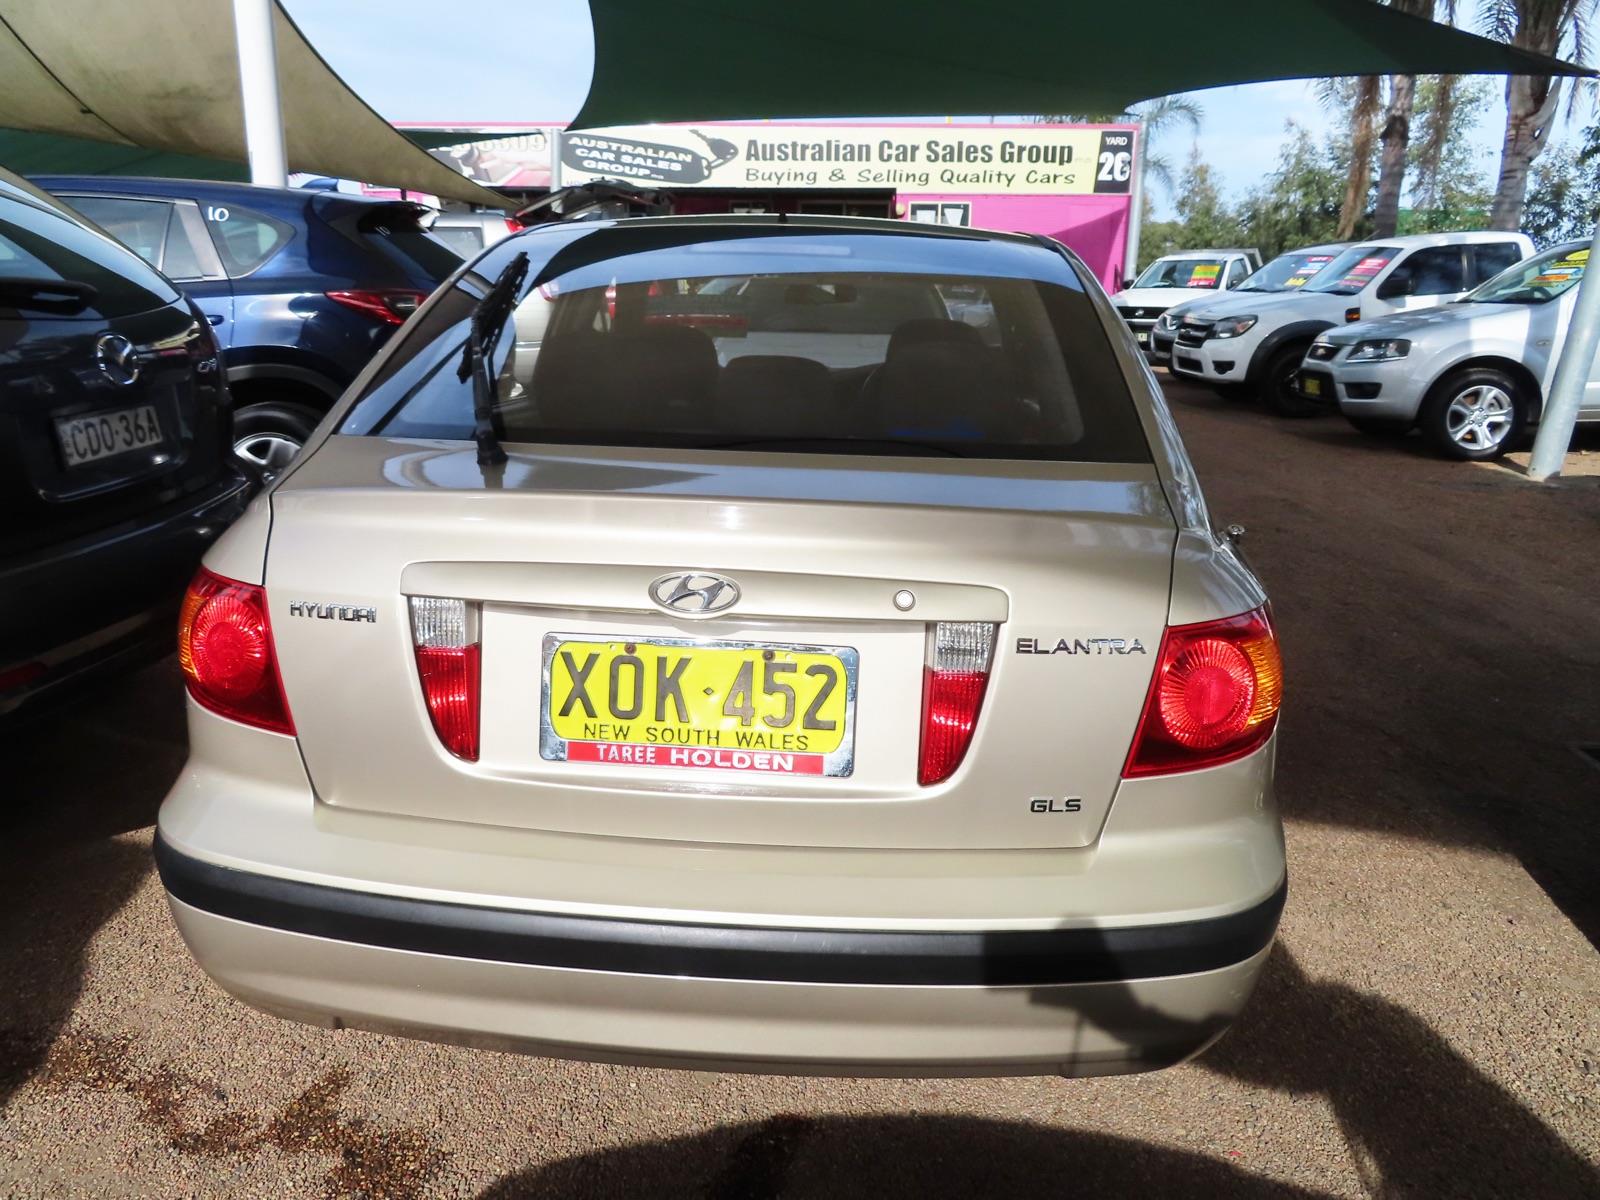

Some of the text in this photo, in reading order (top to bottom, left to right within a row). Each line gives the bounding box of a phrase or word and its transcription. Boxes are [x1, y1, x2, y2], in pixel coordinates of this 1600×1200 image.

[568, 137, 692, 162] AUSTRALIAN
[745, 139, 1074, 166] Australian Car Sales Group
[1105, 136, 1128, 146] YARD
[575, 148, 683, 171] CAR SALES
[582, 160, 651, 176] GROUP
[745, 168, 1076, 187] Buying & Selling Quality Cars
[289, 600, 377, 623] HYUNDAI
[1016, 637, 1147, 655] ELANTRA
[583, 723, 809, 751] NEW SOUTH WALES
[596, 744, 794, 771] TAREE HOLDEN
[1030, 798, 1082, 813] GLS
